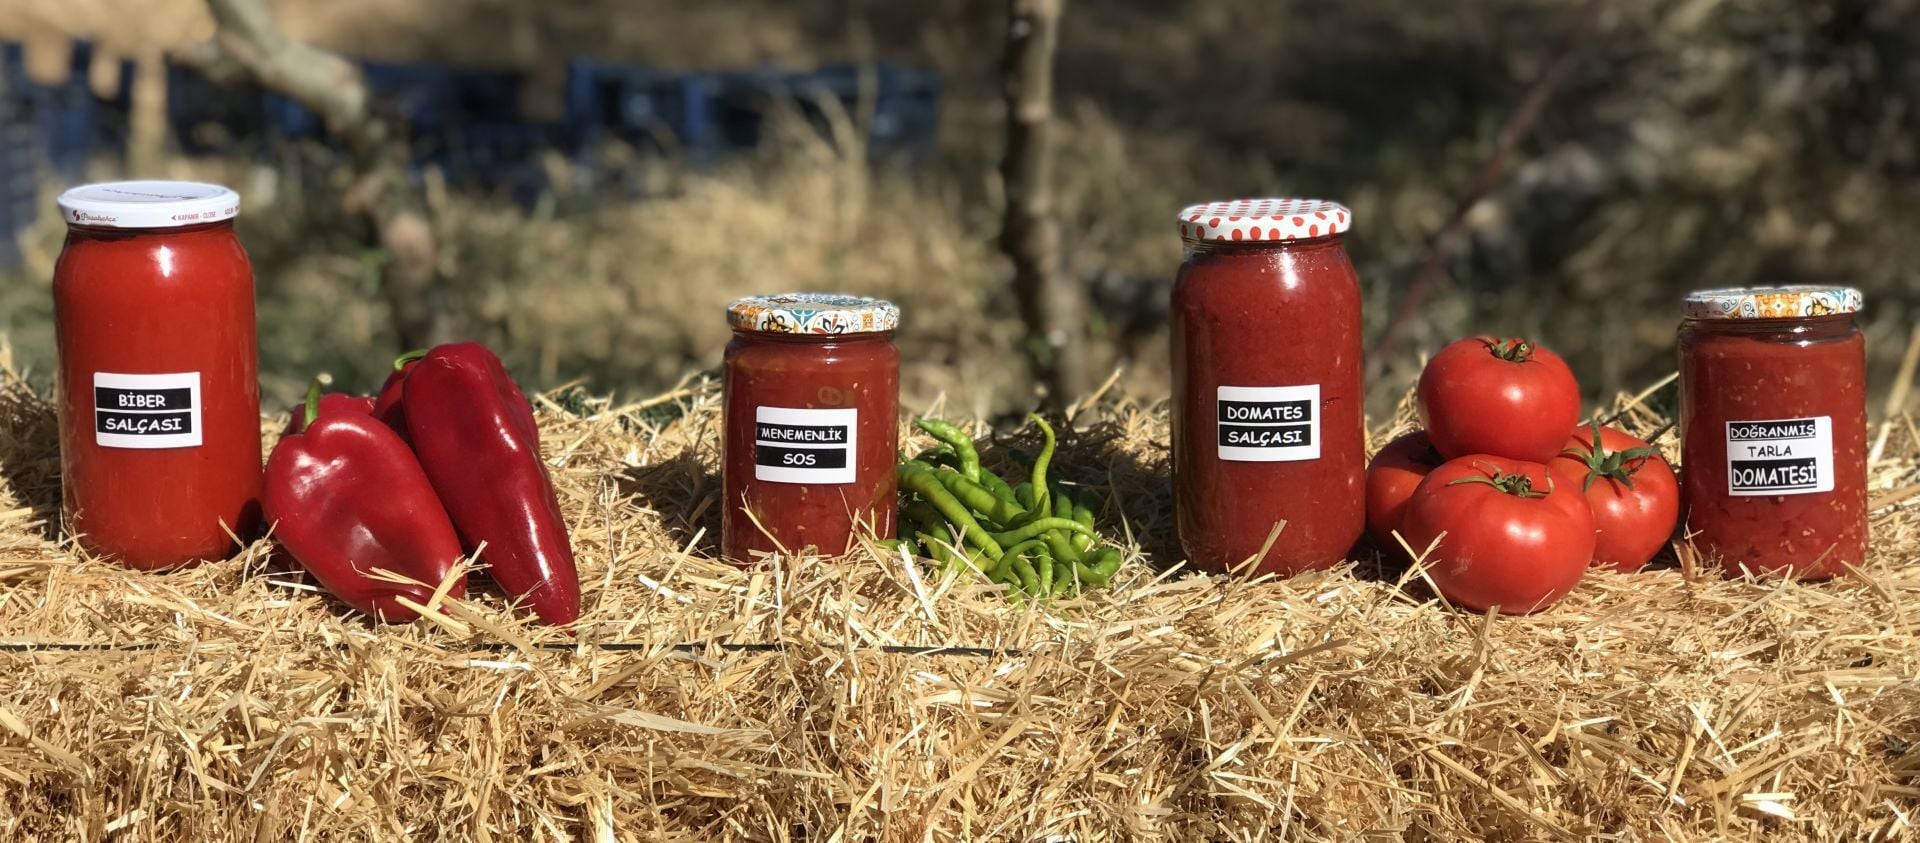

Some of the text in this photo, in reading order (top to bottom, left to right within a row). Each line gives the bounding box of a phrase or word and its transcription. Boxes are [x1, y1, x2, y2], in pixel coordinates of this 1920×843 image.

[118, 392, 166, 408] BİBER
[1227, 405, 1303, 420] DOMATES
[105, 418, 182, 434] SALÇASI
[1730, 424, 1816, 438] DOĞRANMIŞ
[761, 427, 842, 441] MENEMENLİK
[1227, 431, 1303, 447] SALÇASI
[1747, 445, 1792, 457] TARLA
[782, 453, 816, 466] SOS
[1733, 461, 1817, 486] DOMATESİ
